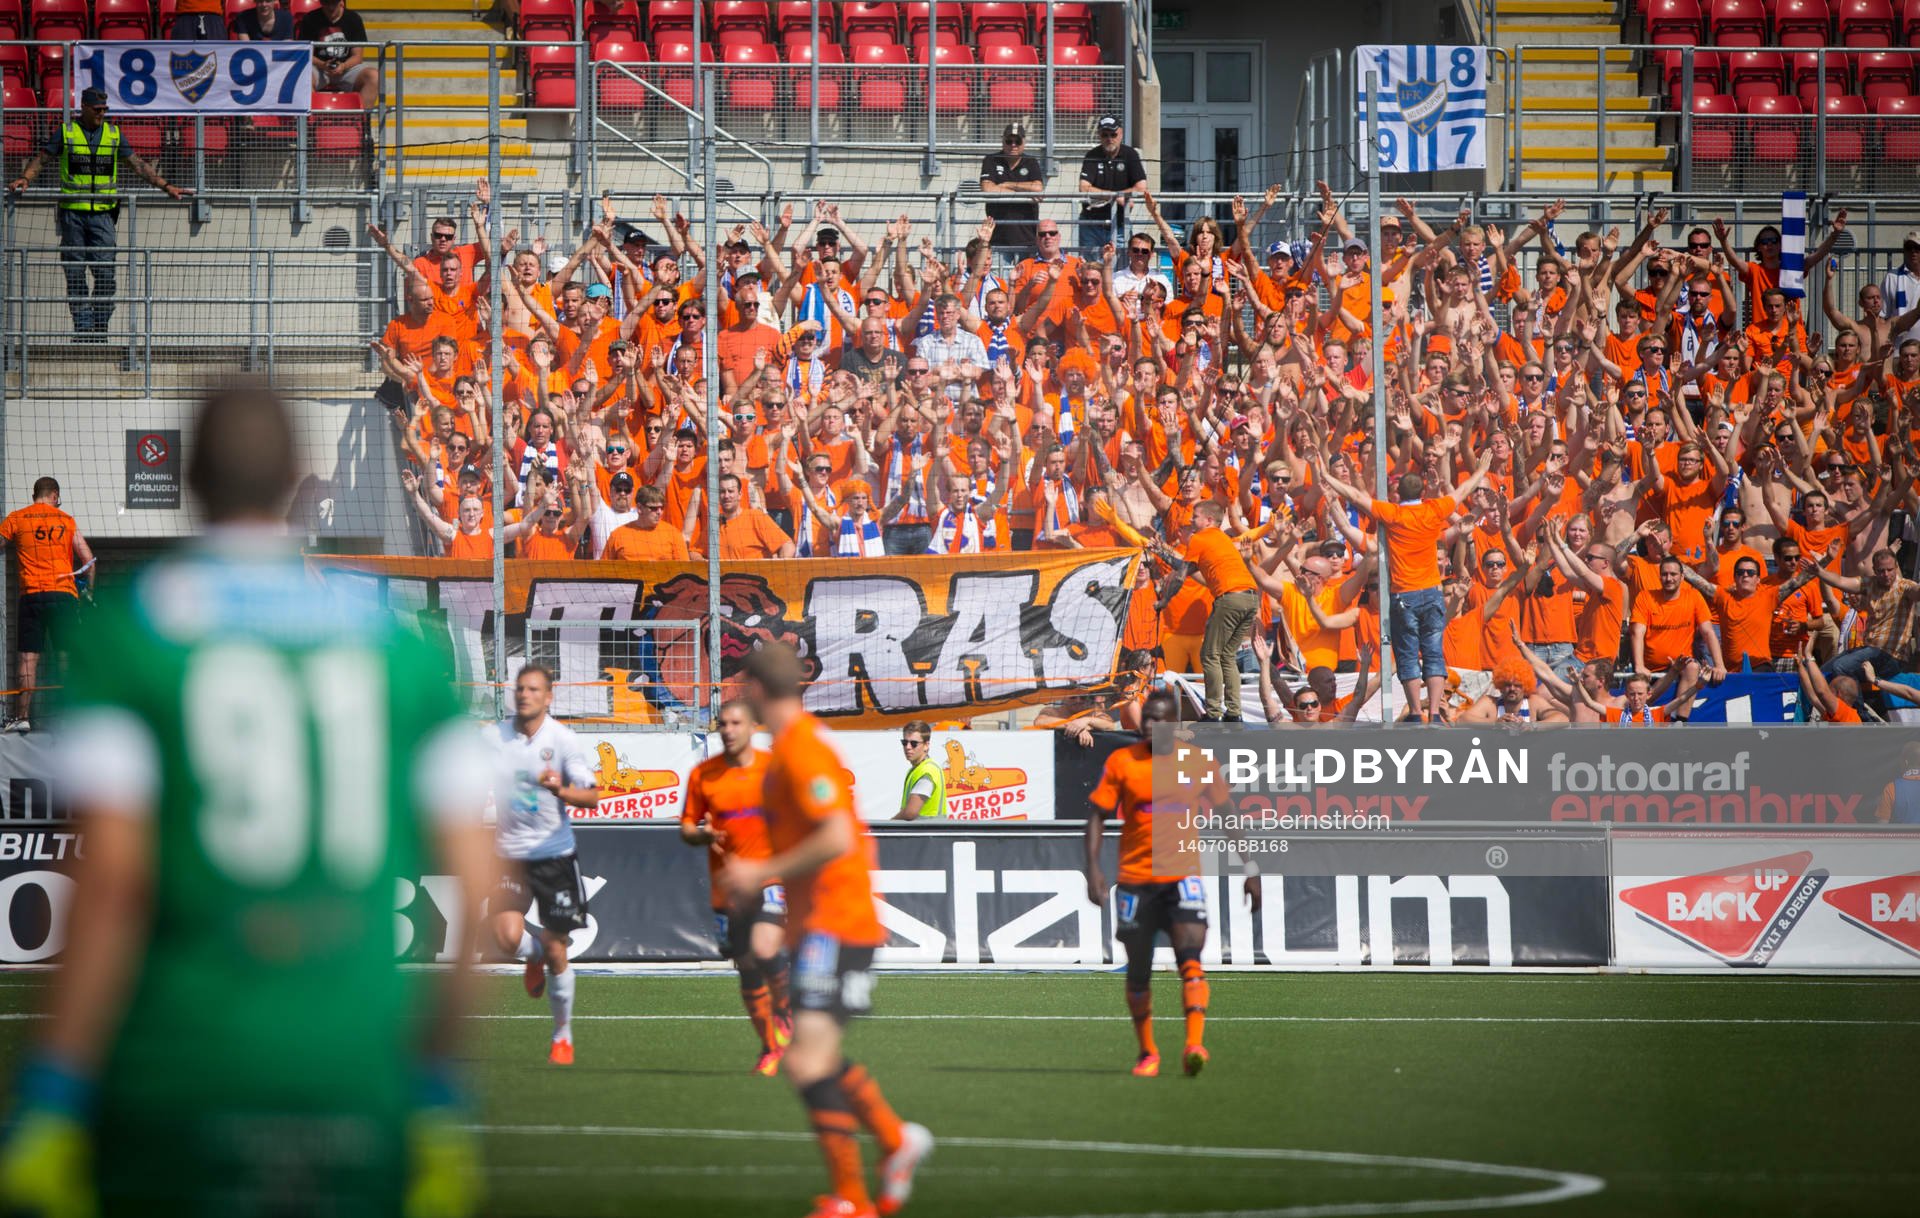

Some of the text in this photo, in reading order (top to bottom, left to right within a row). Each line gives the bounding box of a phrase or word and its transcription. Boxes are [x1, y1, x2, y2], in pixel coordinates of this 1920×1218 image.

[229, 48, 310, 105] 97
[129, 483, 178, 492] FÖRBJUDEN
[135, 472, 173, 481] RÖKNING
[1667, 868, 1790, 922] BACK UP
[1753, 877, 1820, 965] SKYLT & DEKOR
